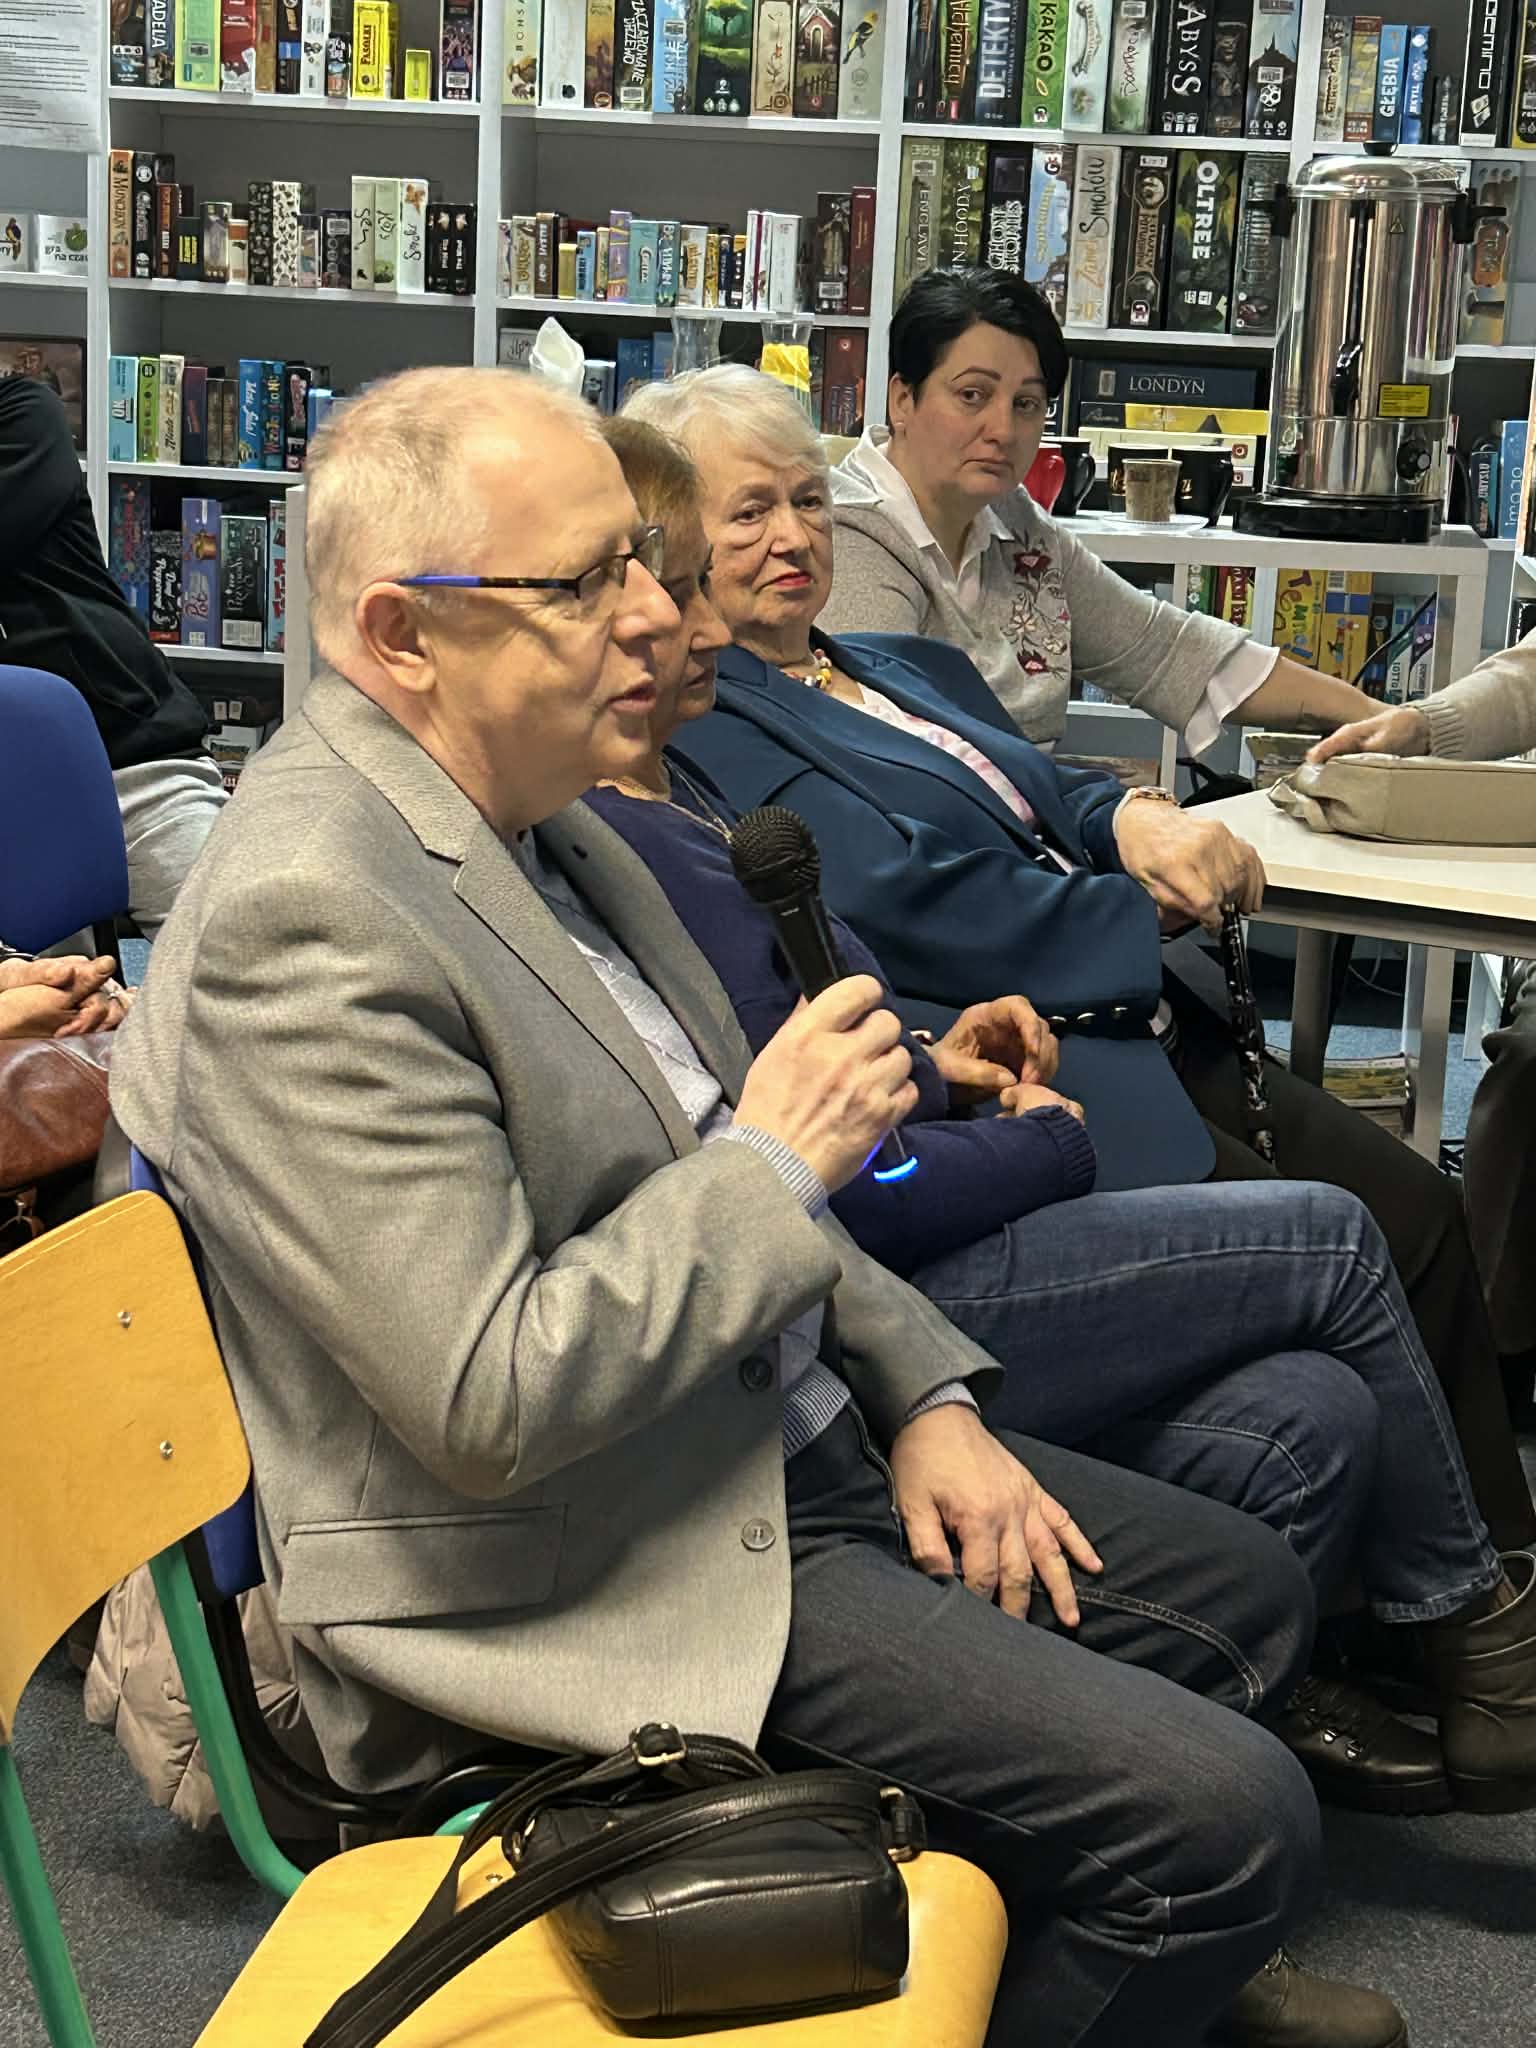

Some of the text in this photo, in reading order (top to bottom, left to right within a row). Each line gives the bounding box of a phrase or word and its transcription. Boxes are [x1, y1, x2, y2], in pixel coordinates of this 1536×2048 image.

[151, 0, 167, 48] ADELA
[1036, 2, 1057, 71] KAKAO
[1129, 375, 1205, 394] LONDYN
